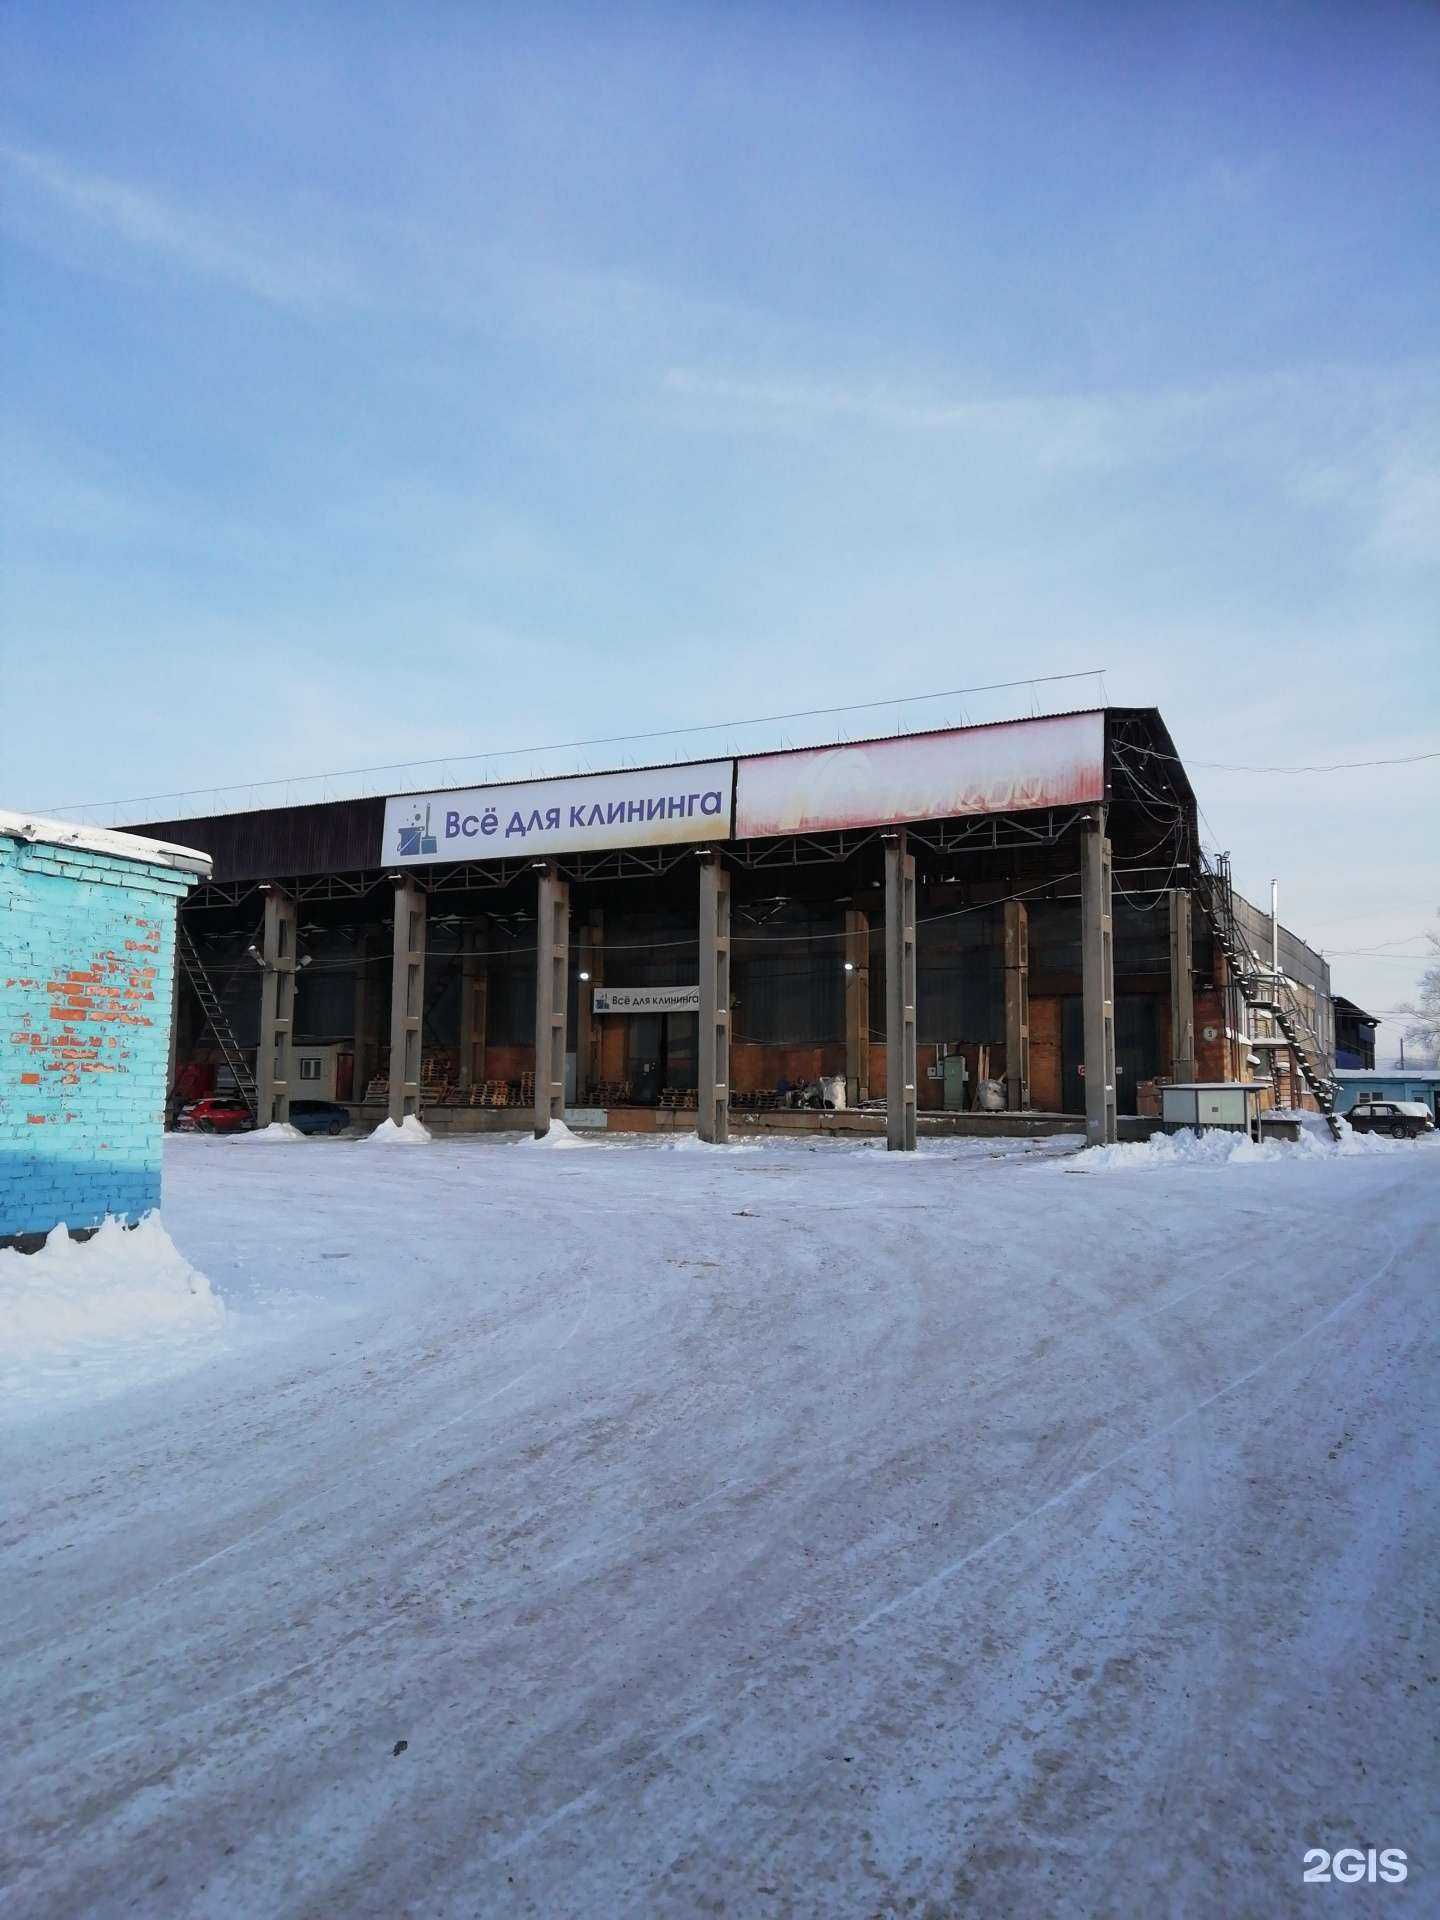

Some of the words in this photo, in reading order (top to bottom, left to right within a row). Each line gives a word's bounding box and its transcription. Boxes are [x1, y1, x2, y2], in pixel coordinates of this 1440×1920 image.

[445, 807, 499, 839] Всё
[505, 807, 561, 838] для
[569, 790, 723, 828] клининга
[612, 995, 631, 1006] Всё
[632, 997, 651, 1007] для
[652, 995, 699, 1006] клининга
